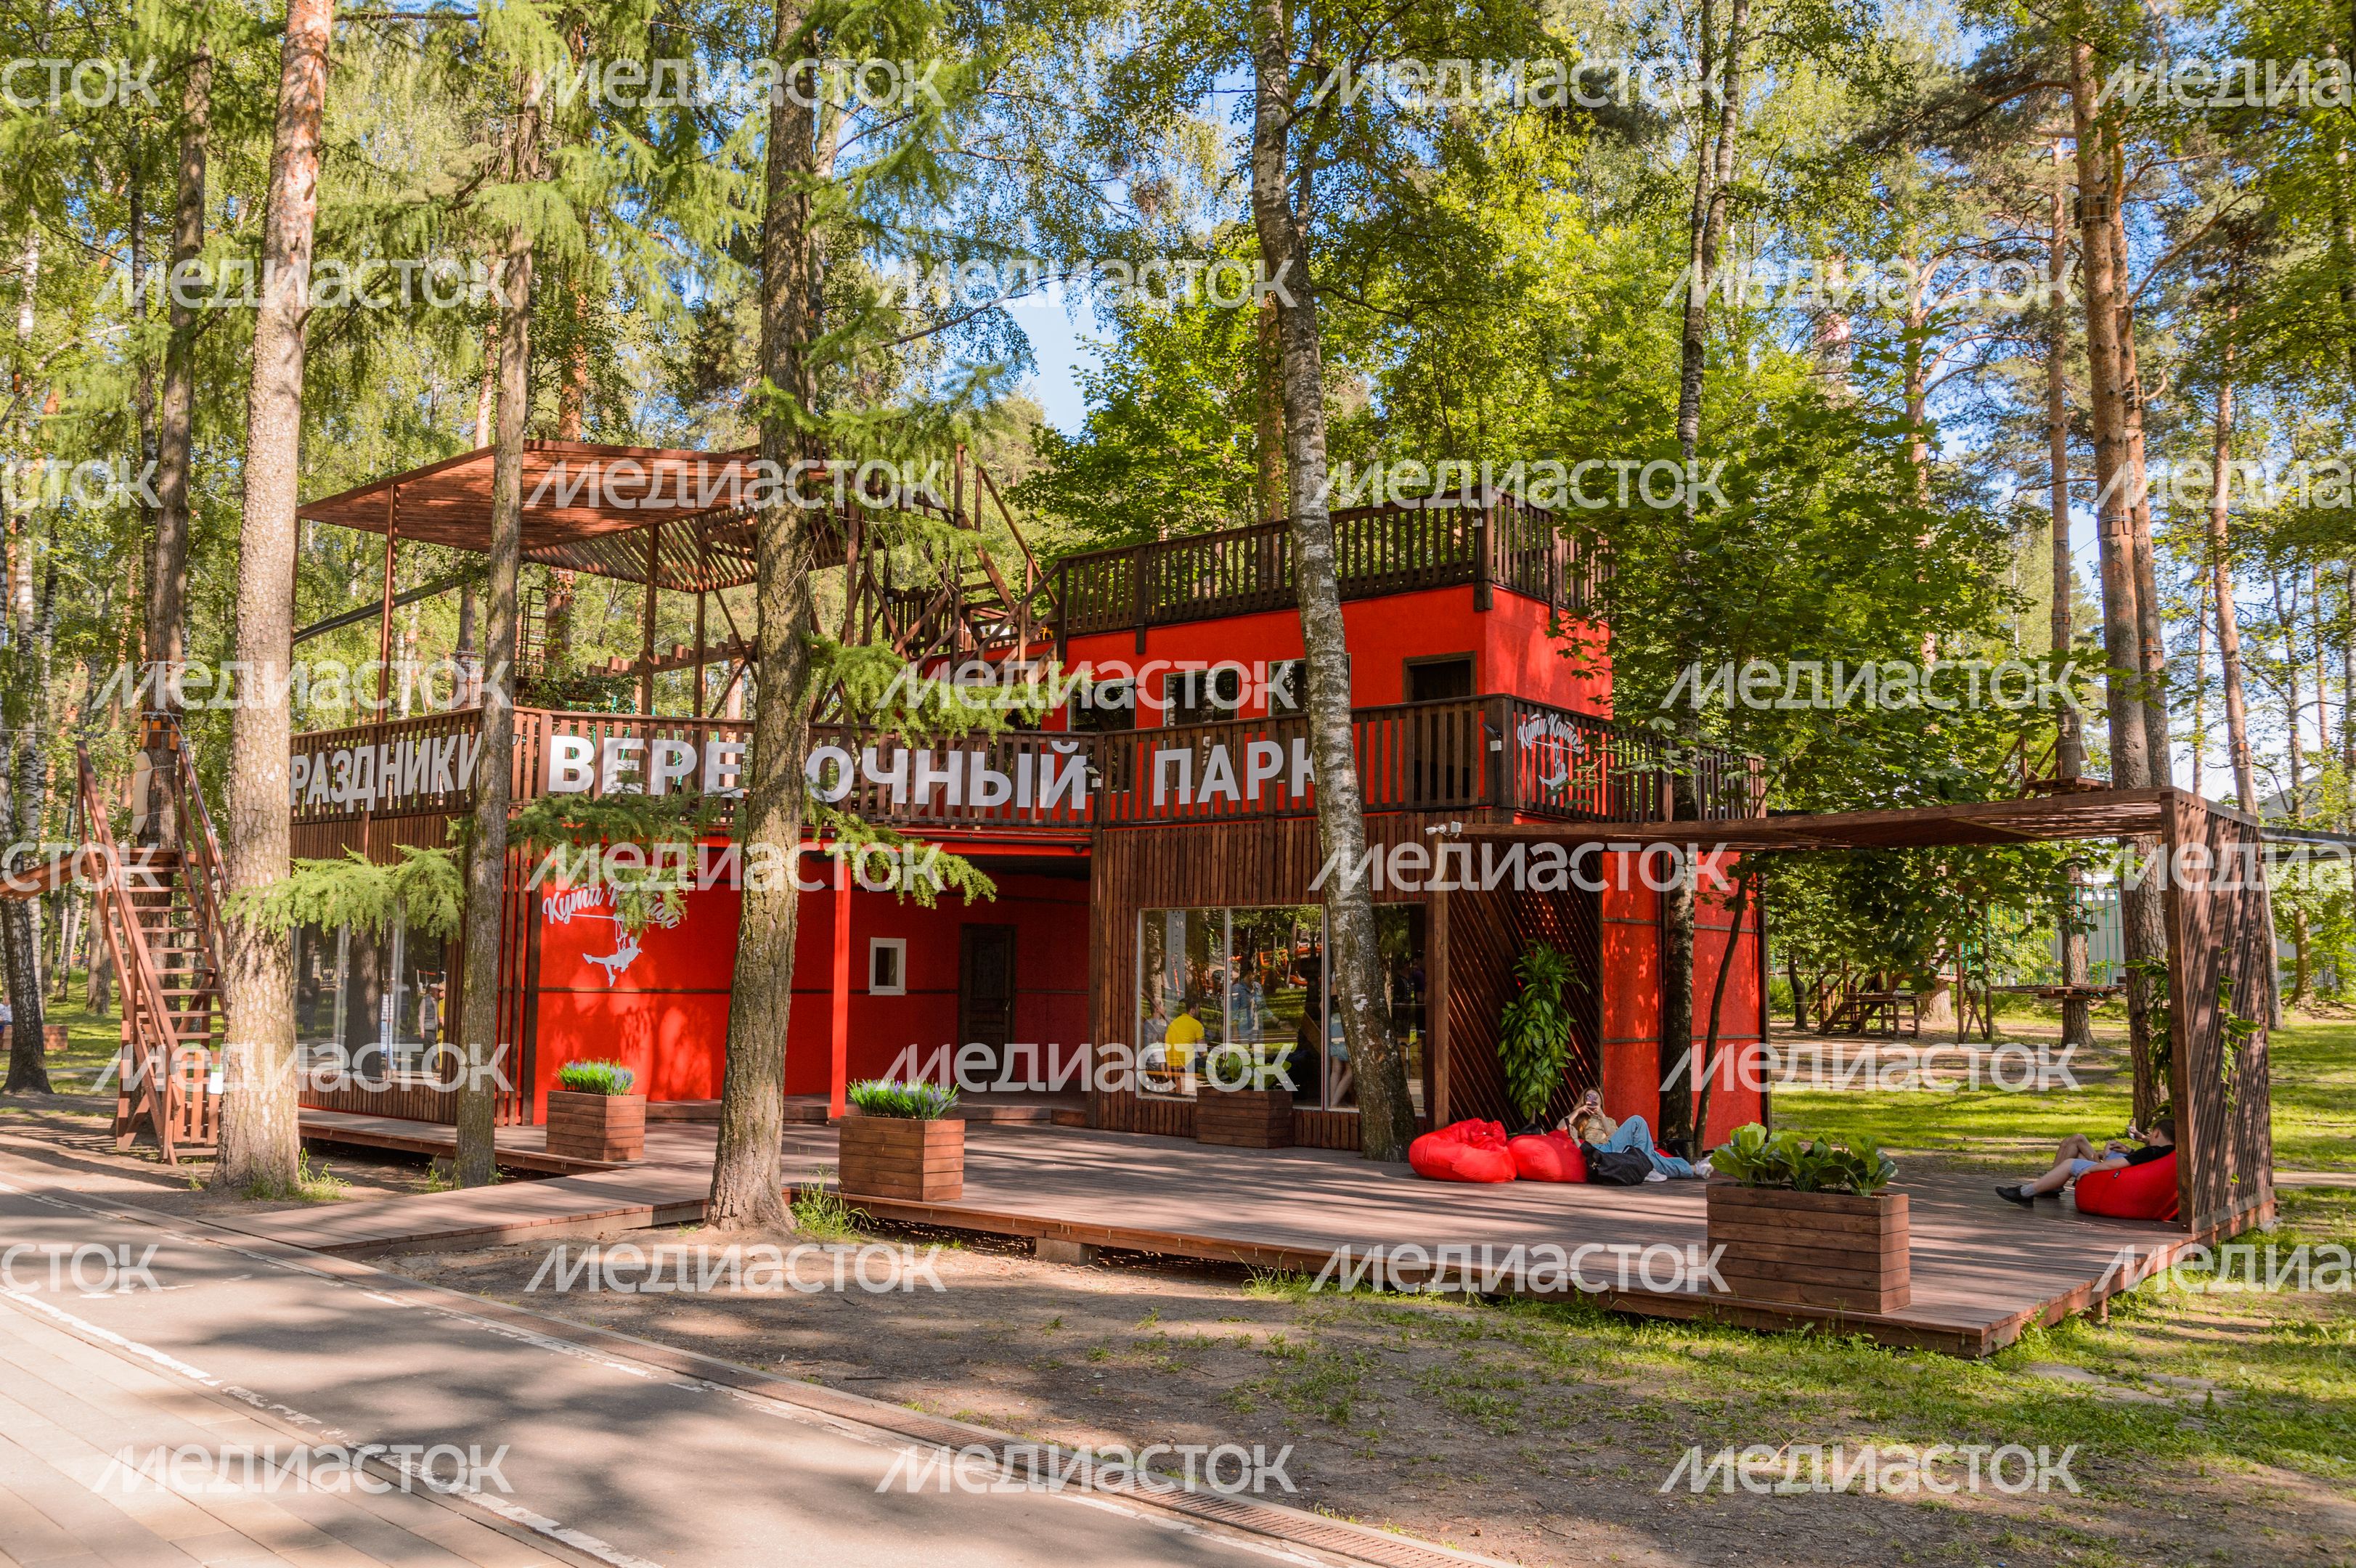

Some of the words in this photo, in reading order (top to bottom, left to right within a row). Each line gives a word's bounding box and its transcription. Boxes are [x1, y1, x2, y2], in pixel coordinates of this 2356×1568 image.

[290, 732, 482, 813] РАЗДНИКИ
[547, 735, 1087, 810] ВЕРЕОЧНЫЙ
[1154, 738, 1316, 807] ПАРК
